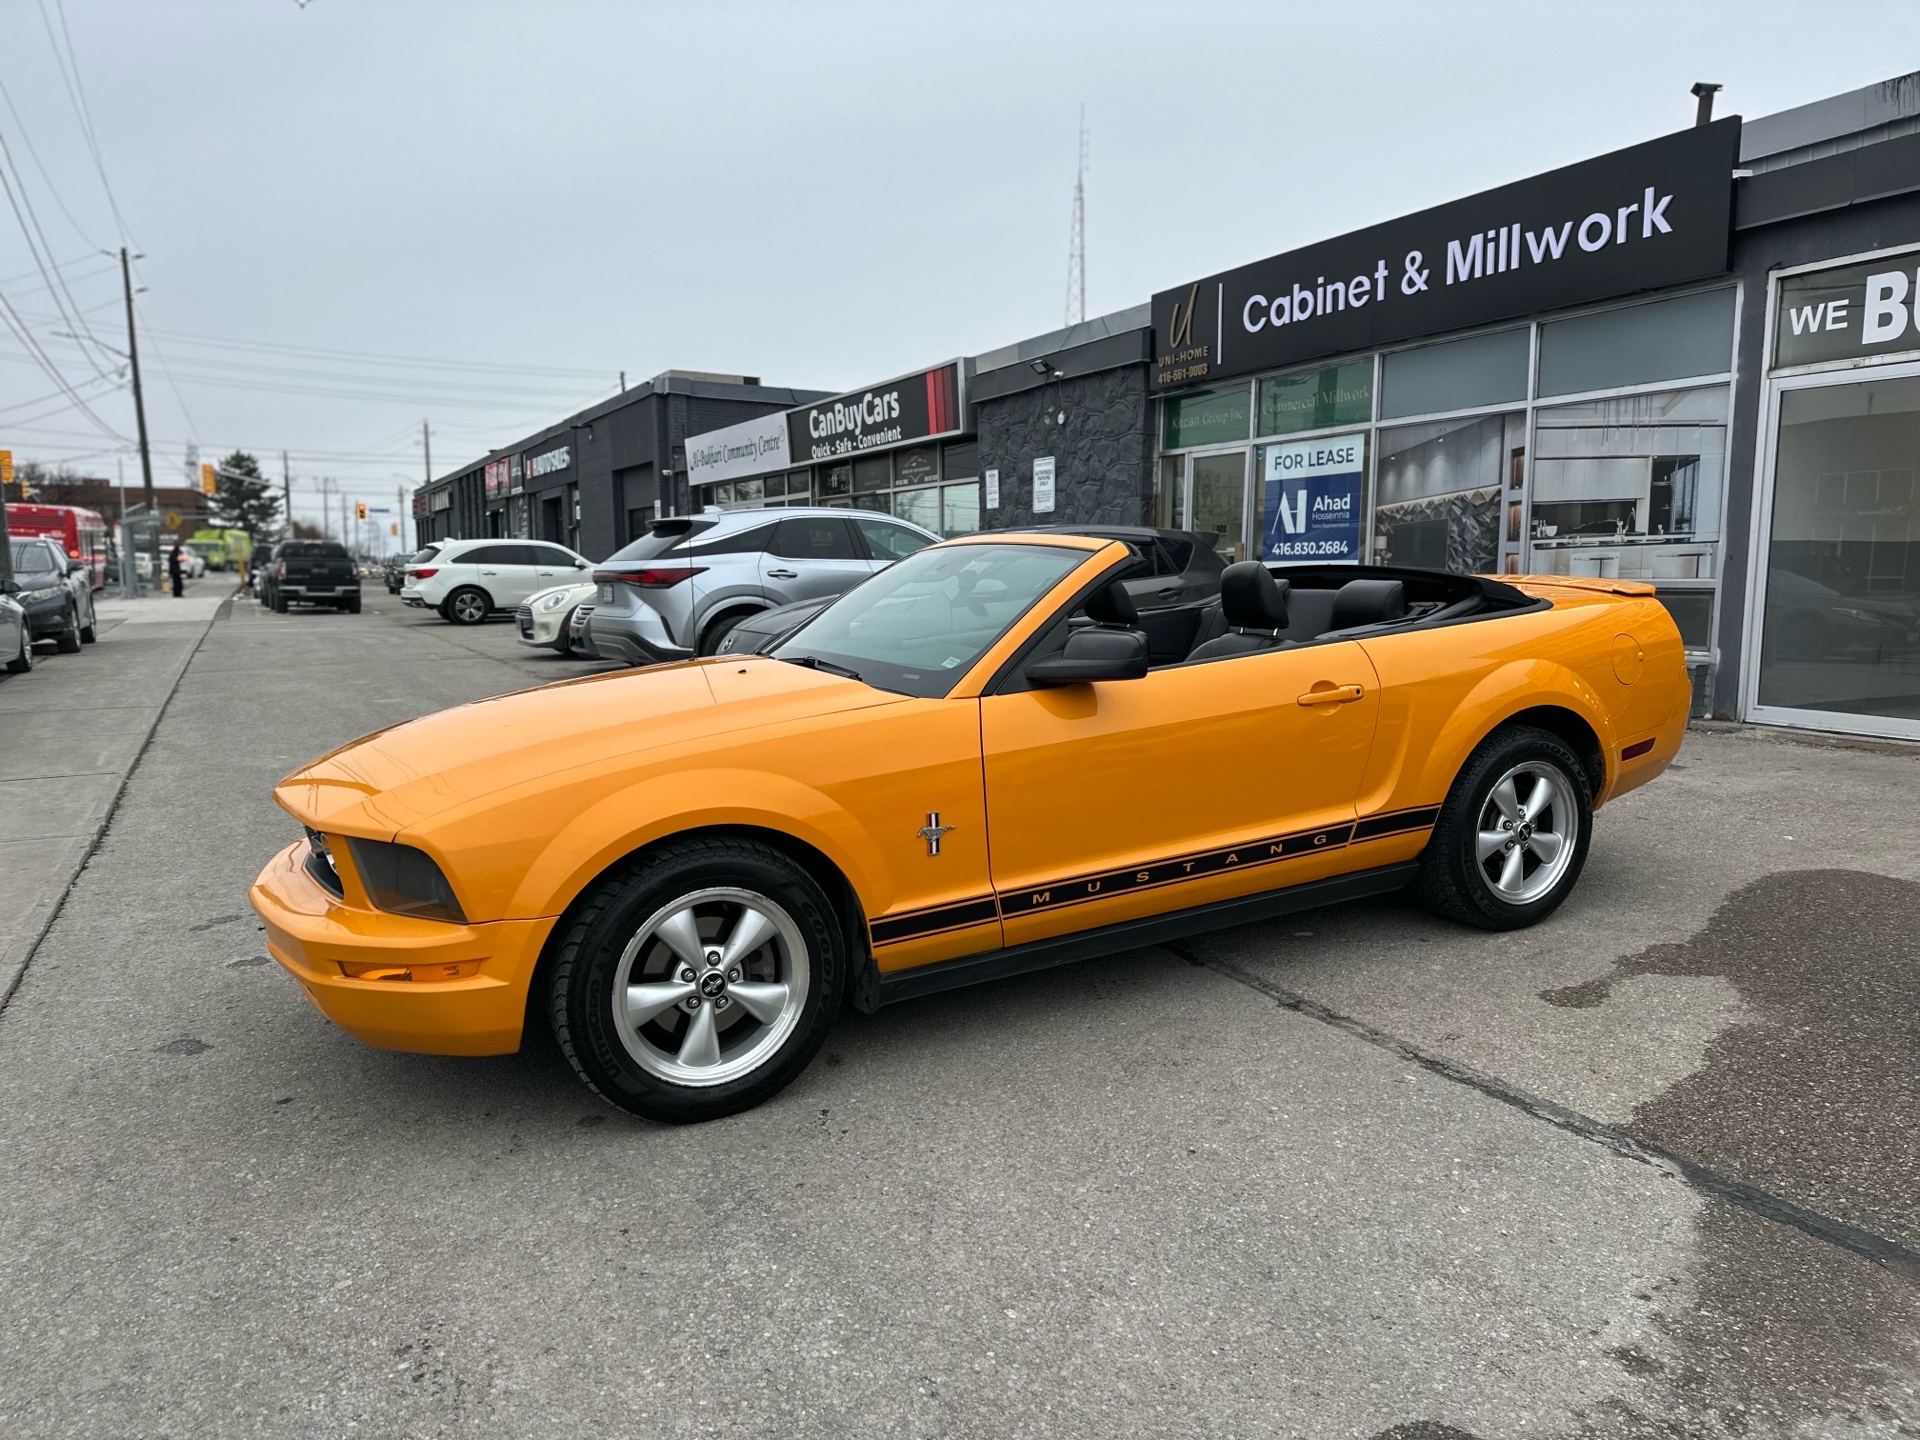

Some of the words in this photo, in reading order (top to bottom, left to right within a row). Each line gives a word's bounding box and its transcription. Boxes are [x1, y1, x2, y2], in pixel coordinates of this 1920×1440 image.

[1243, 259, 1389, 333] Cabinet
[1400, 250, 1430, 295] &
[1445, 186, 1675, 286] Millwork
[1789, 298, 1850, 336] WE
[1158, 345, 1210, 368] UNI-HOME
[1157, 363, 1209, 384] 416-661-0003
[809, 391, 900, 439] CanBuyCars
[1262, 393, 1319, 415] Commercial
[1322, 386, 1370, 405] Millwork
[811, 442, 831, 460] Quick
[835, 437, 852, 454] Safe
[857, 425, 901, 449] Convenient
[1274, 453, 1304, 471] FOR
[1308, 447, 1355, 468] LEASE
[1312, 493, 1351, 511] Ahad
[1272, 540, 1349, 556] 416.830.2684
[1030, 833, 1328, 906] MUSTANG
